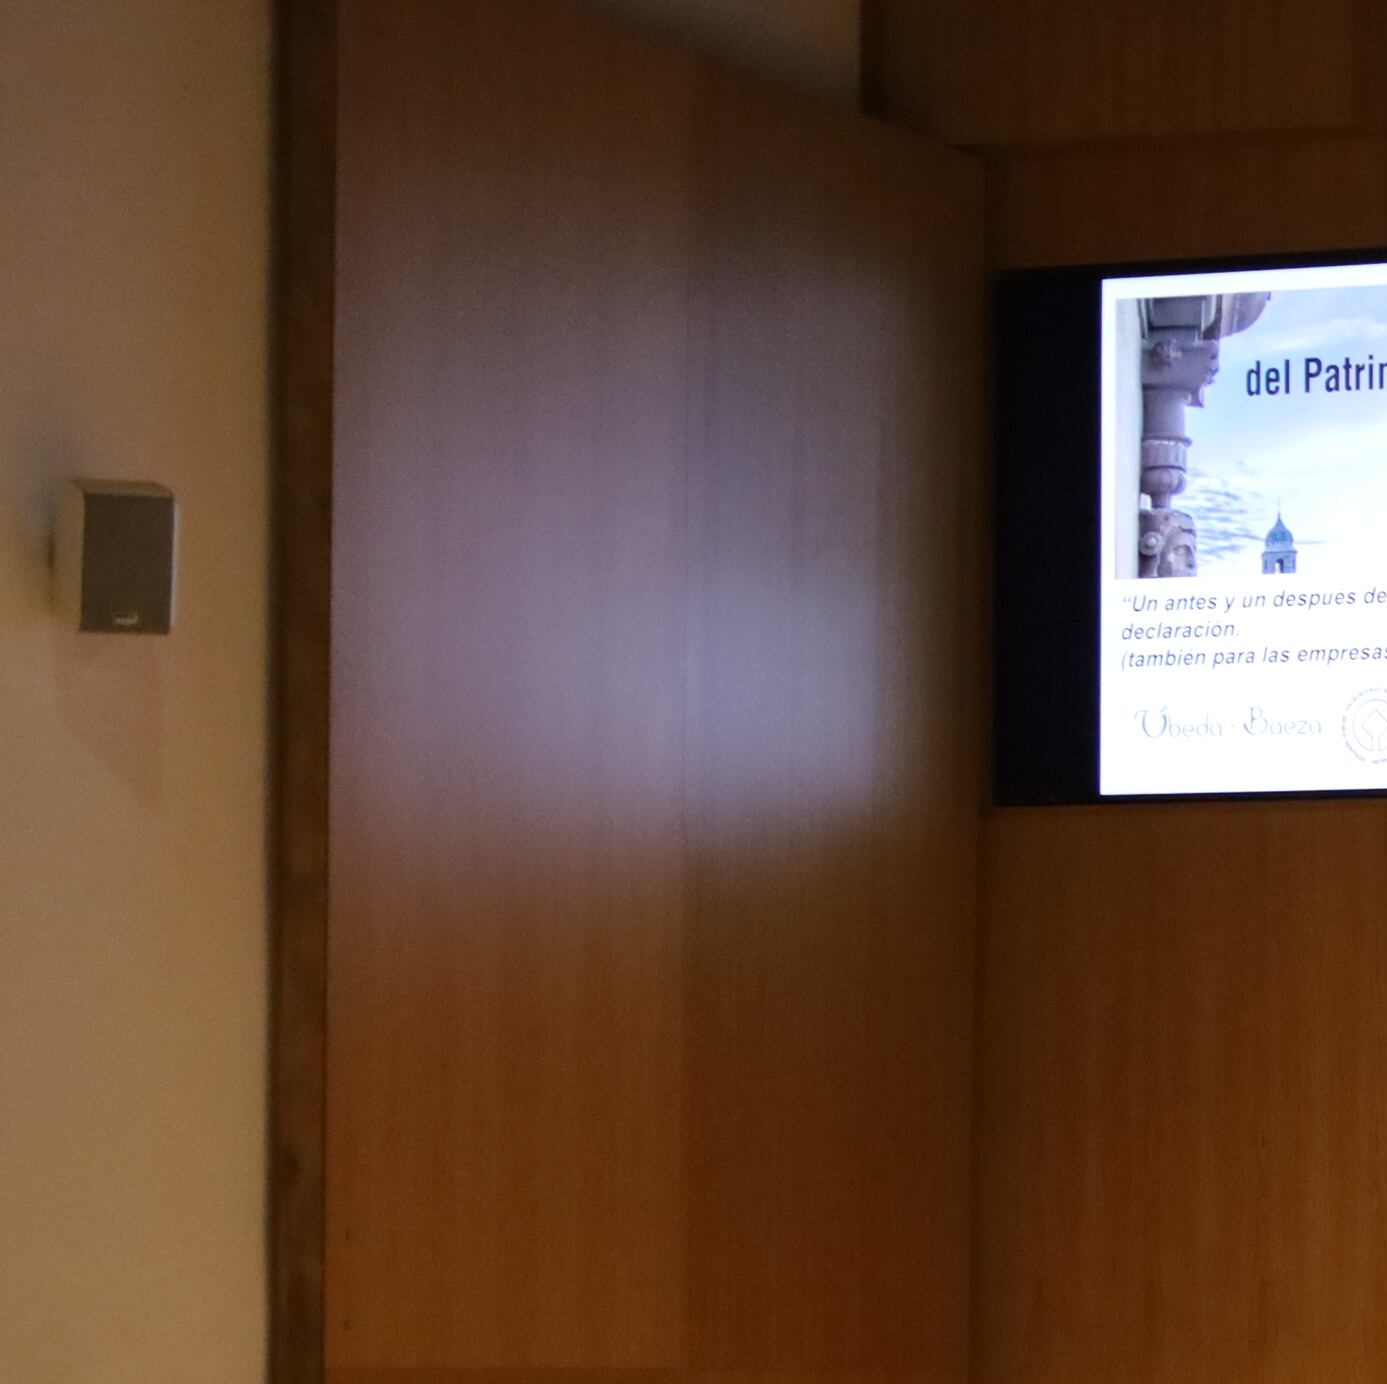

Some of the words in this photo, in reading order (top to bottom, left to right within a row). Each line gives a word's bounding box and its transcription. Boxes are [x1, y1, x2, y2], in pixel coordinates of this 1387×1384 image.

[1246, 358, 1291, 396] del
[1164, 593, 1217, 611] antes
[1224, 595, 1236, 614] y
[1242, 595, 1265, 609] un
[1273, 589, 1356, 610] después
[1363, 587, 1387, 604] de
[1121, 649, 1206, 671] (también
[1212, 651, 1256, 669] para
[1262, 646, 1290, 664] las
[1134, 705, 1222, 738] Úbeda
[1243, 706, 1322, 735] Baeza
